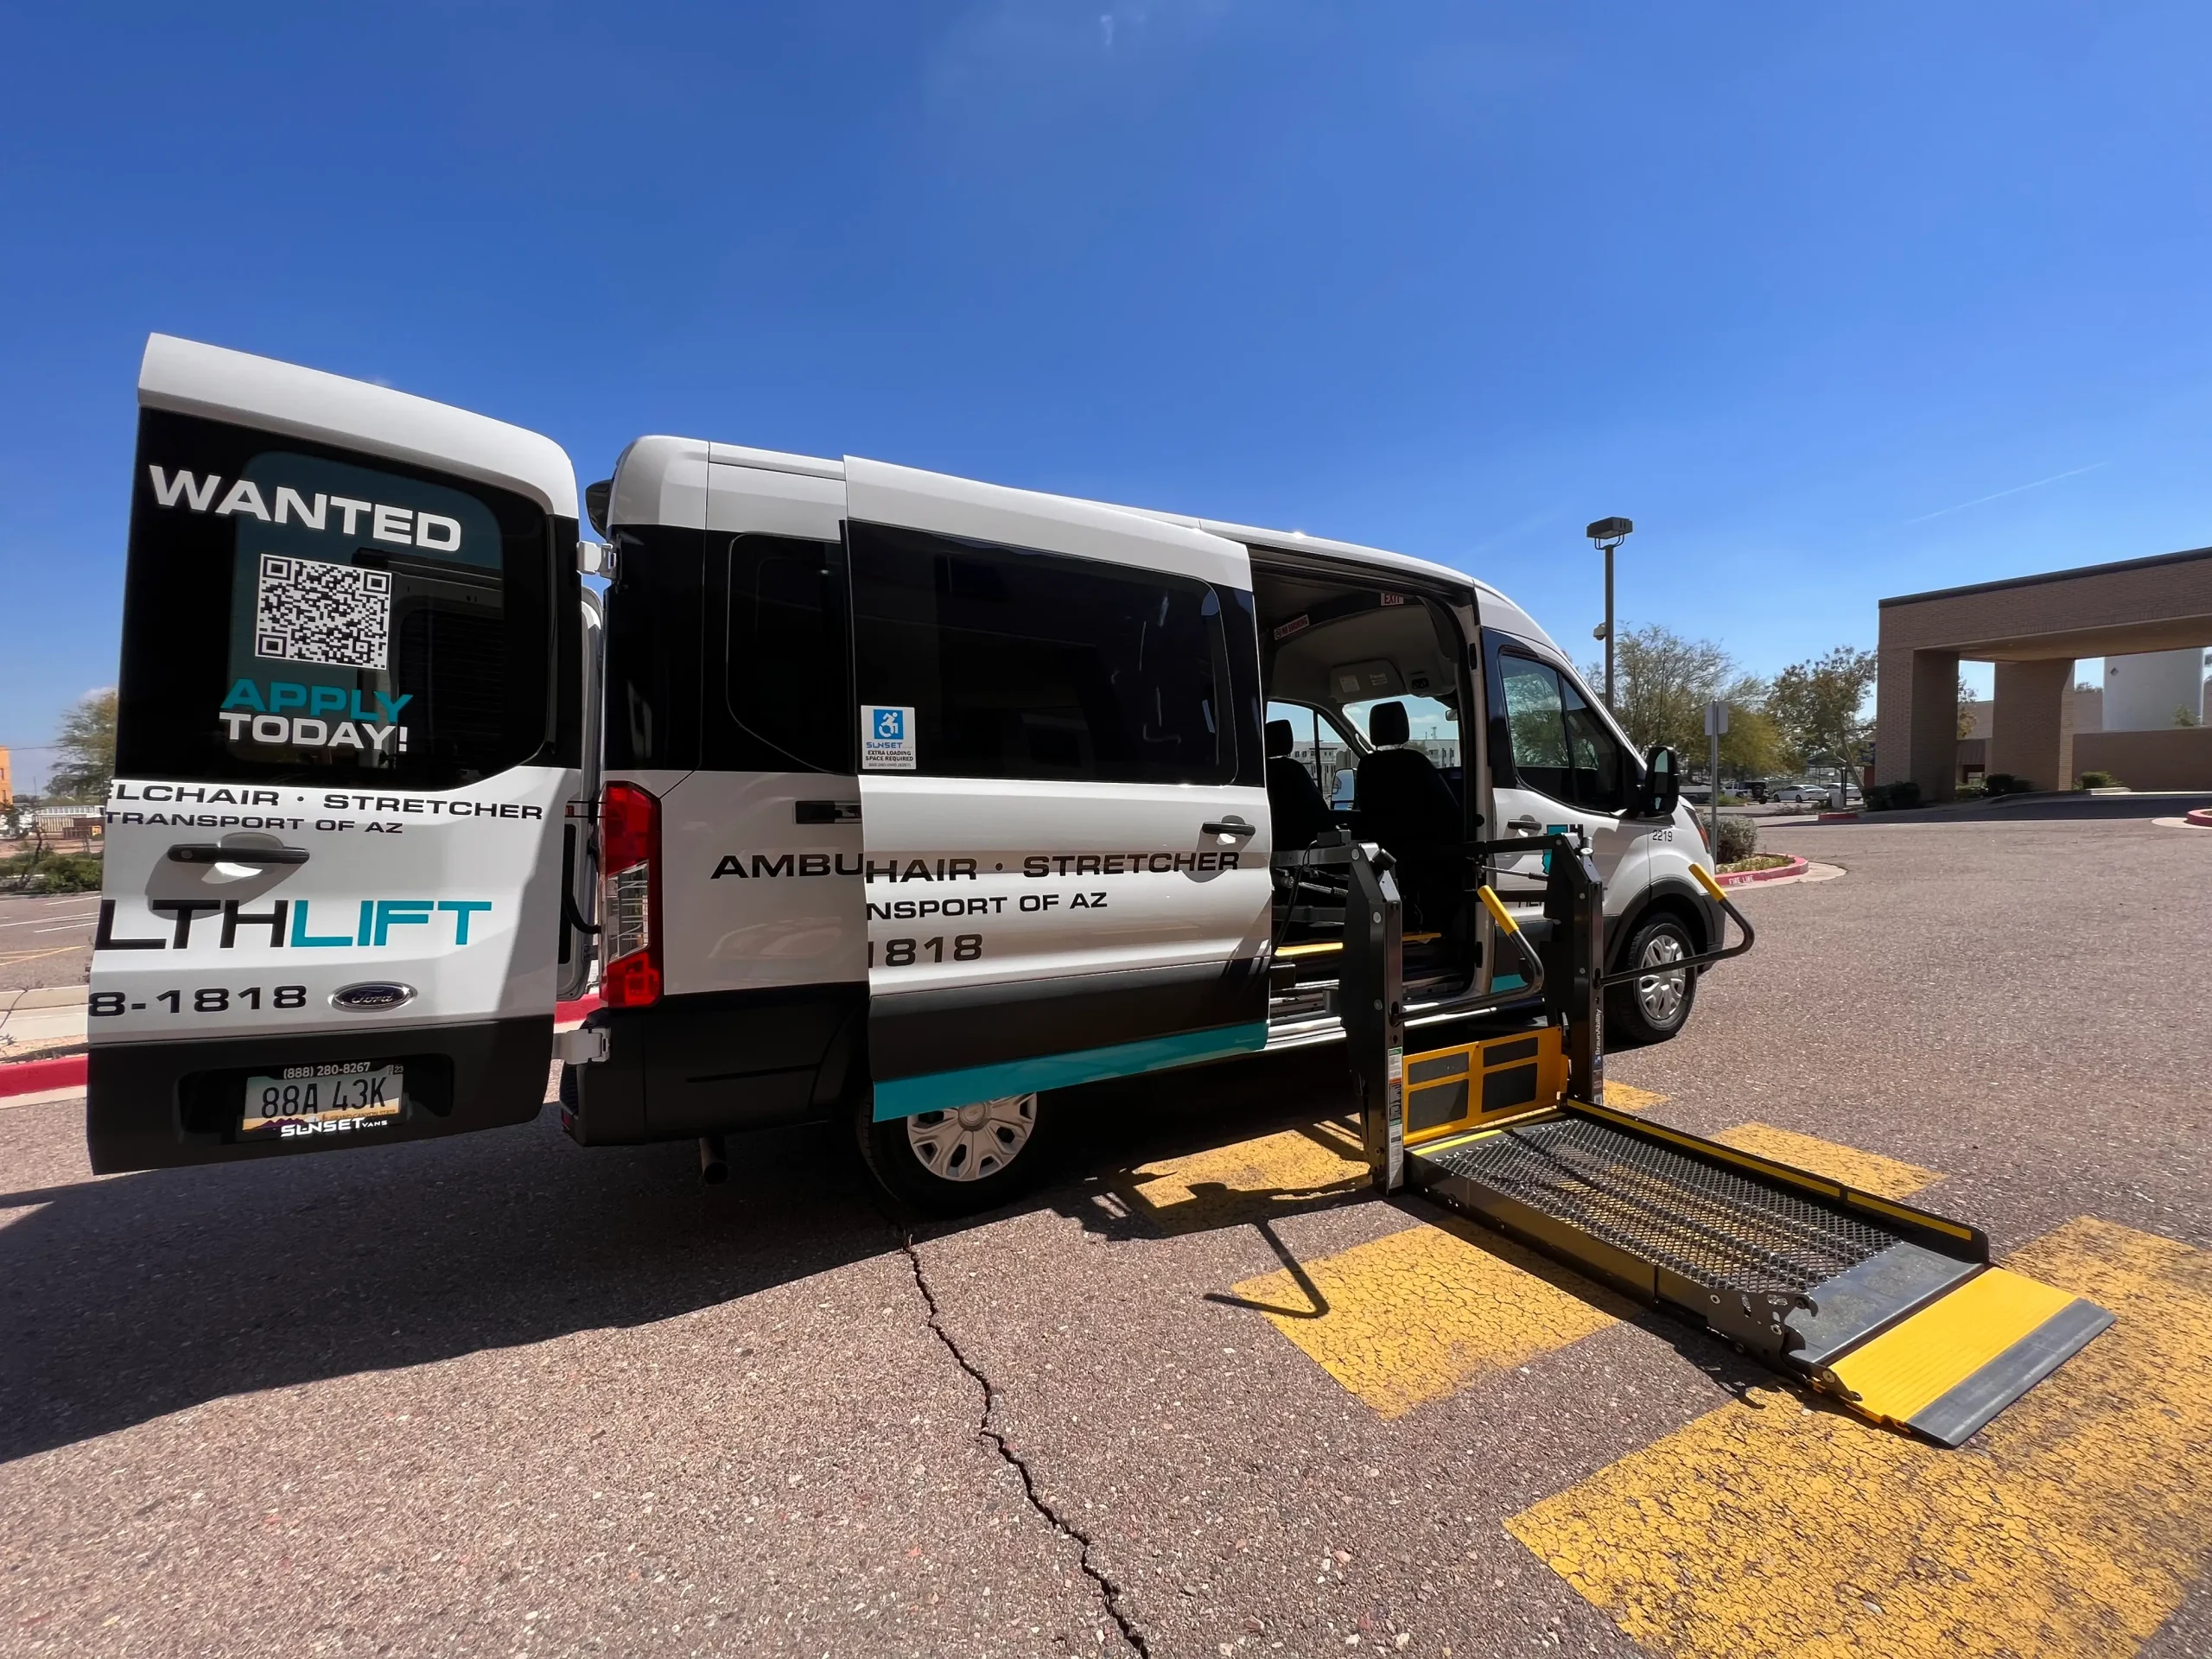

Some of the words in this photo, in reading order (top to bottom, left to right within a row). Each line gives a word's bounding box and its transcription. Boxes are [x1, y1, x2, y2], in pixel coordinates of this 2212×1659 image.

[149, 465, 461, 551] WANTED
[1385, 594, 1399, 604] EXIT
[221, 678, 413, 723] APPLY
[219, 712, 408, 752] TODAY!
[110, 783, 279, 806] LCHAIR
[323, 794, 543, 820] STRETCHER
[105, 811, 304, 830] TRANSPORT
[315, 819, 355, 832] OF
[364, 822, 404, 834] AZ
[1652, 830, 1673, 842] 2219
[710, 853, 863, 880] AMBU
[866, 858, 977, 883] HAIR
[1023, 852, 1240, 878] STRETCHER
[867, 897, 1007, 920] NSPORT
[1020, 894, 1059, 912] OF
[1070, 892, 1108, 909] AZ
[88, 985, 307, 1017] 8-1818
[352, 989, 394, 1004] Ford
[283, 1065, 314, 1079] (888)
[317, 1062, 371, 1076] 280-8267
[261, 1083, 318, 1118] 88A
[332, 1077, 387, 1111] 43K
[280, 1117, 365, 1137] SUNSET
